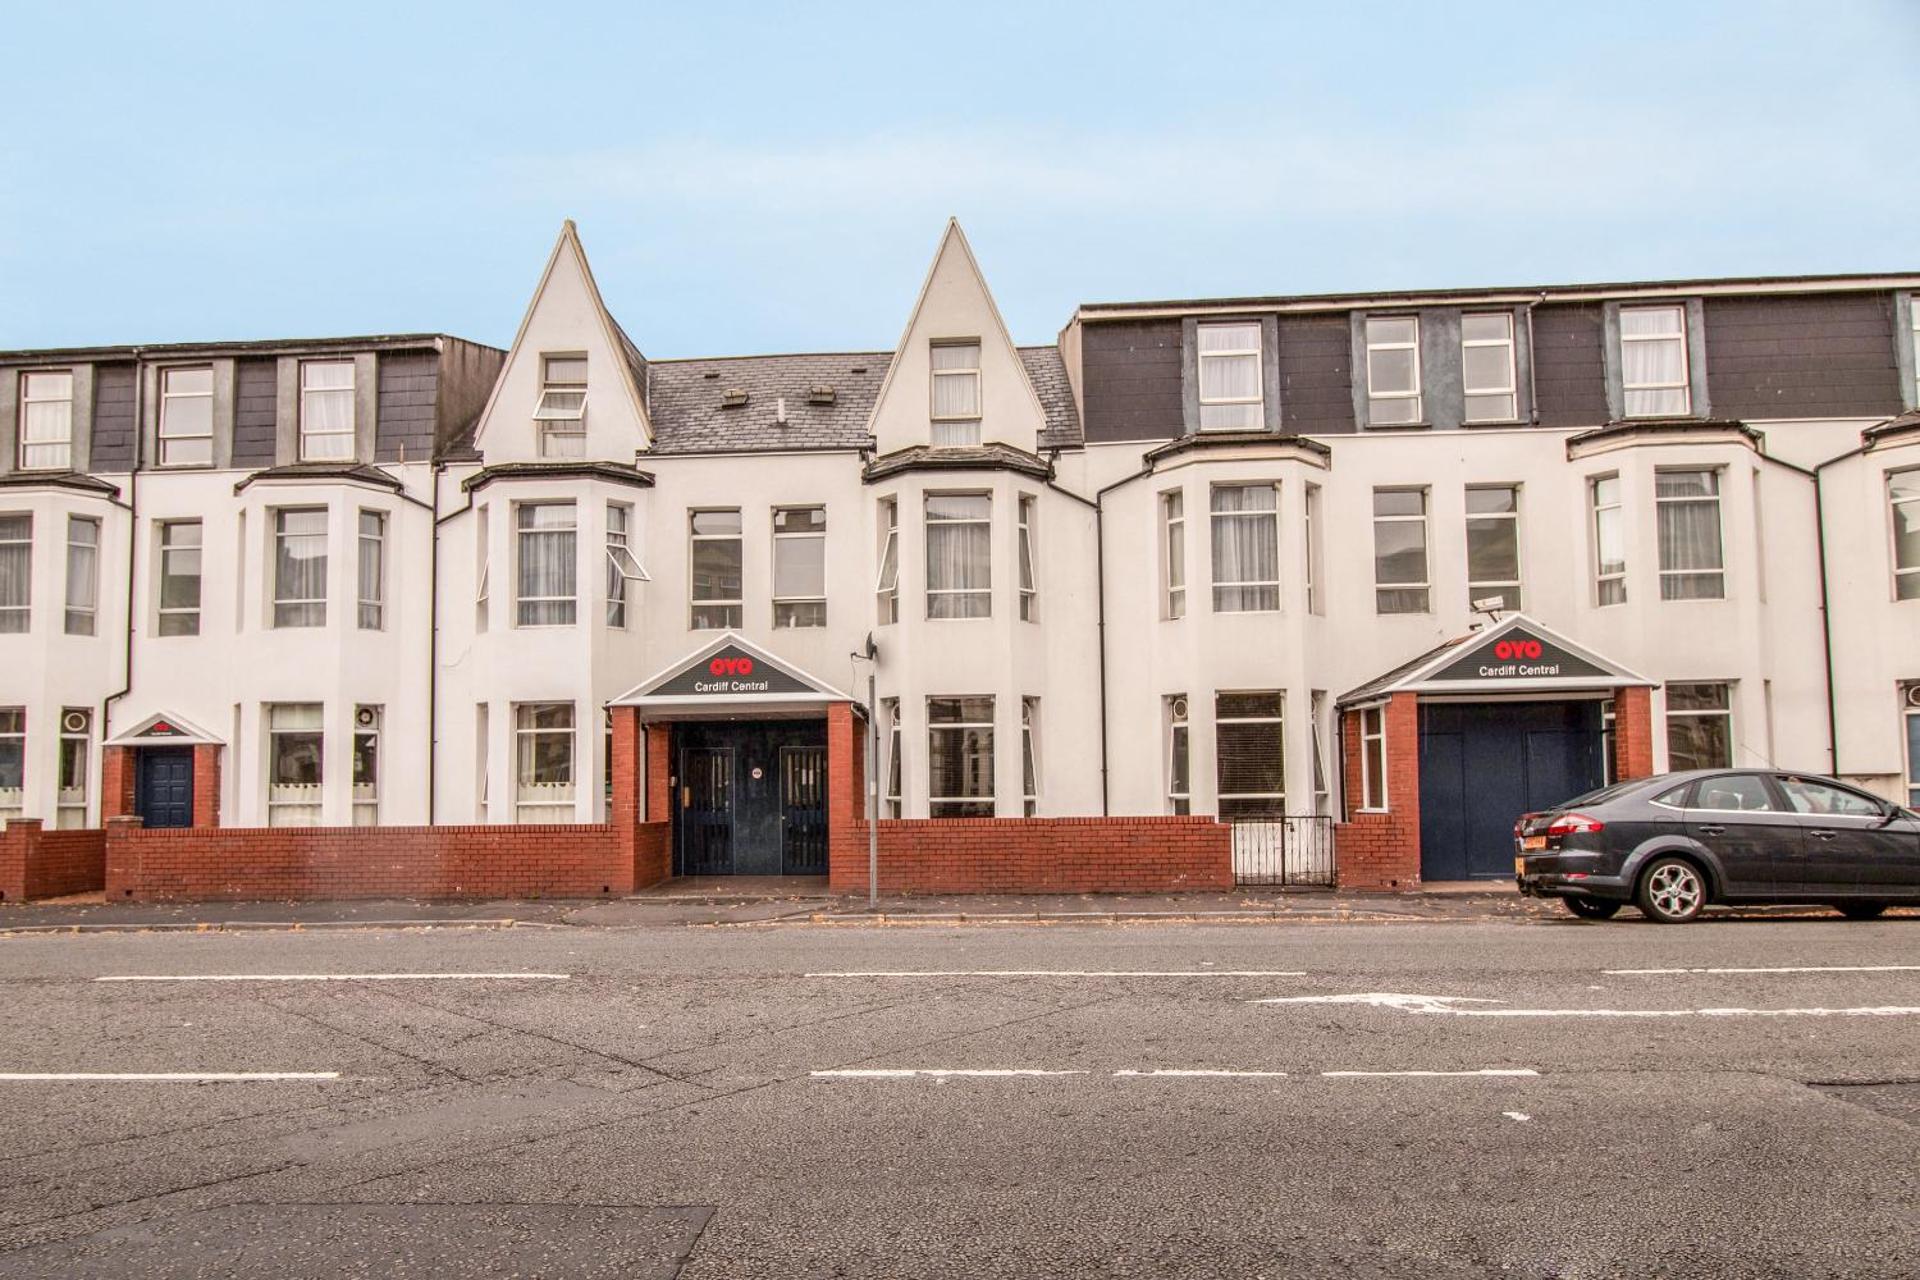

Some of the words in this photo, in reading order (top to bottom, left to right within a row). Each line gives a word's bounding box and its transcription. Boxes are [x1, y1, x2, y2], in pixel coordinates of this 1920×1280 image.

[1494, 639, 1542, 660] OYO
[709, 657, 753, 676] OYO
[1479, 665, 1516, 677] Cardiff
[1518, 664, 1559, 676] Central
[694, 682, 729, 692] Cardiff
[731, 680, 768, 691] Central
